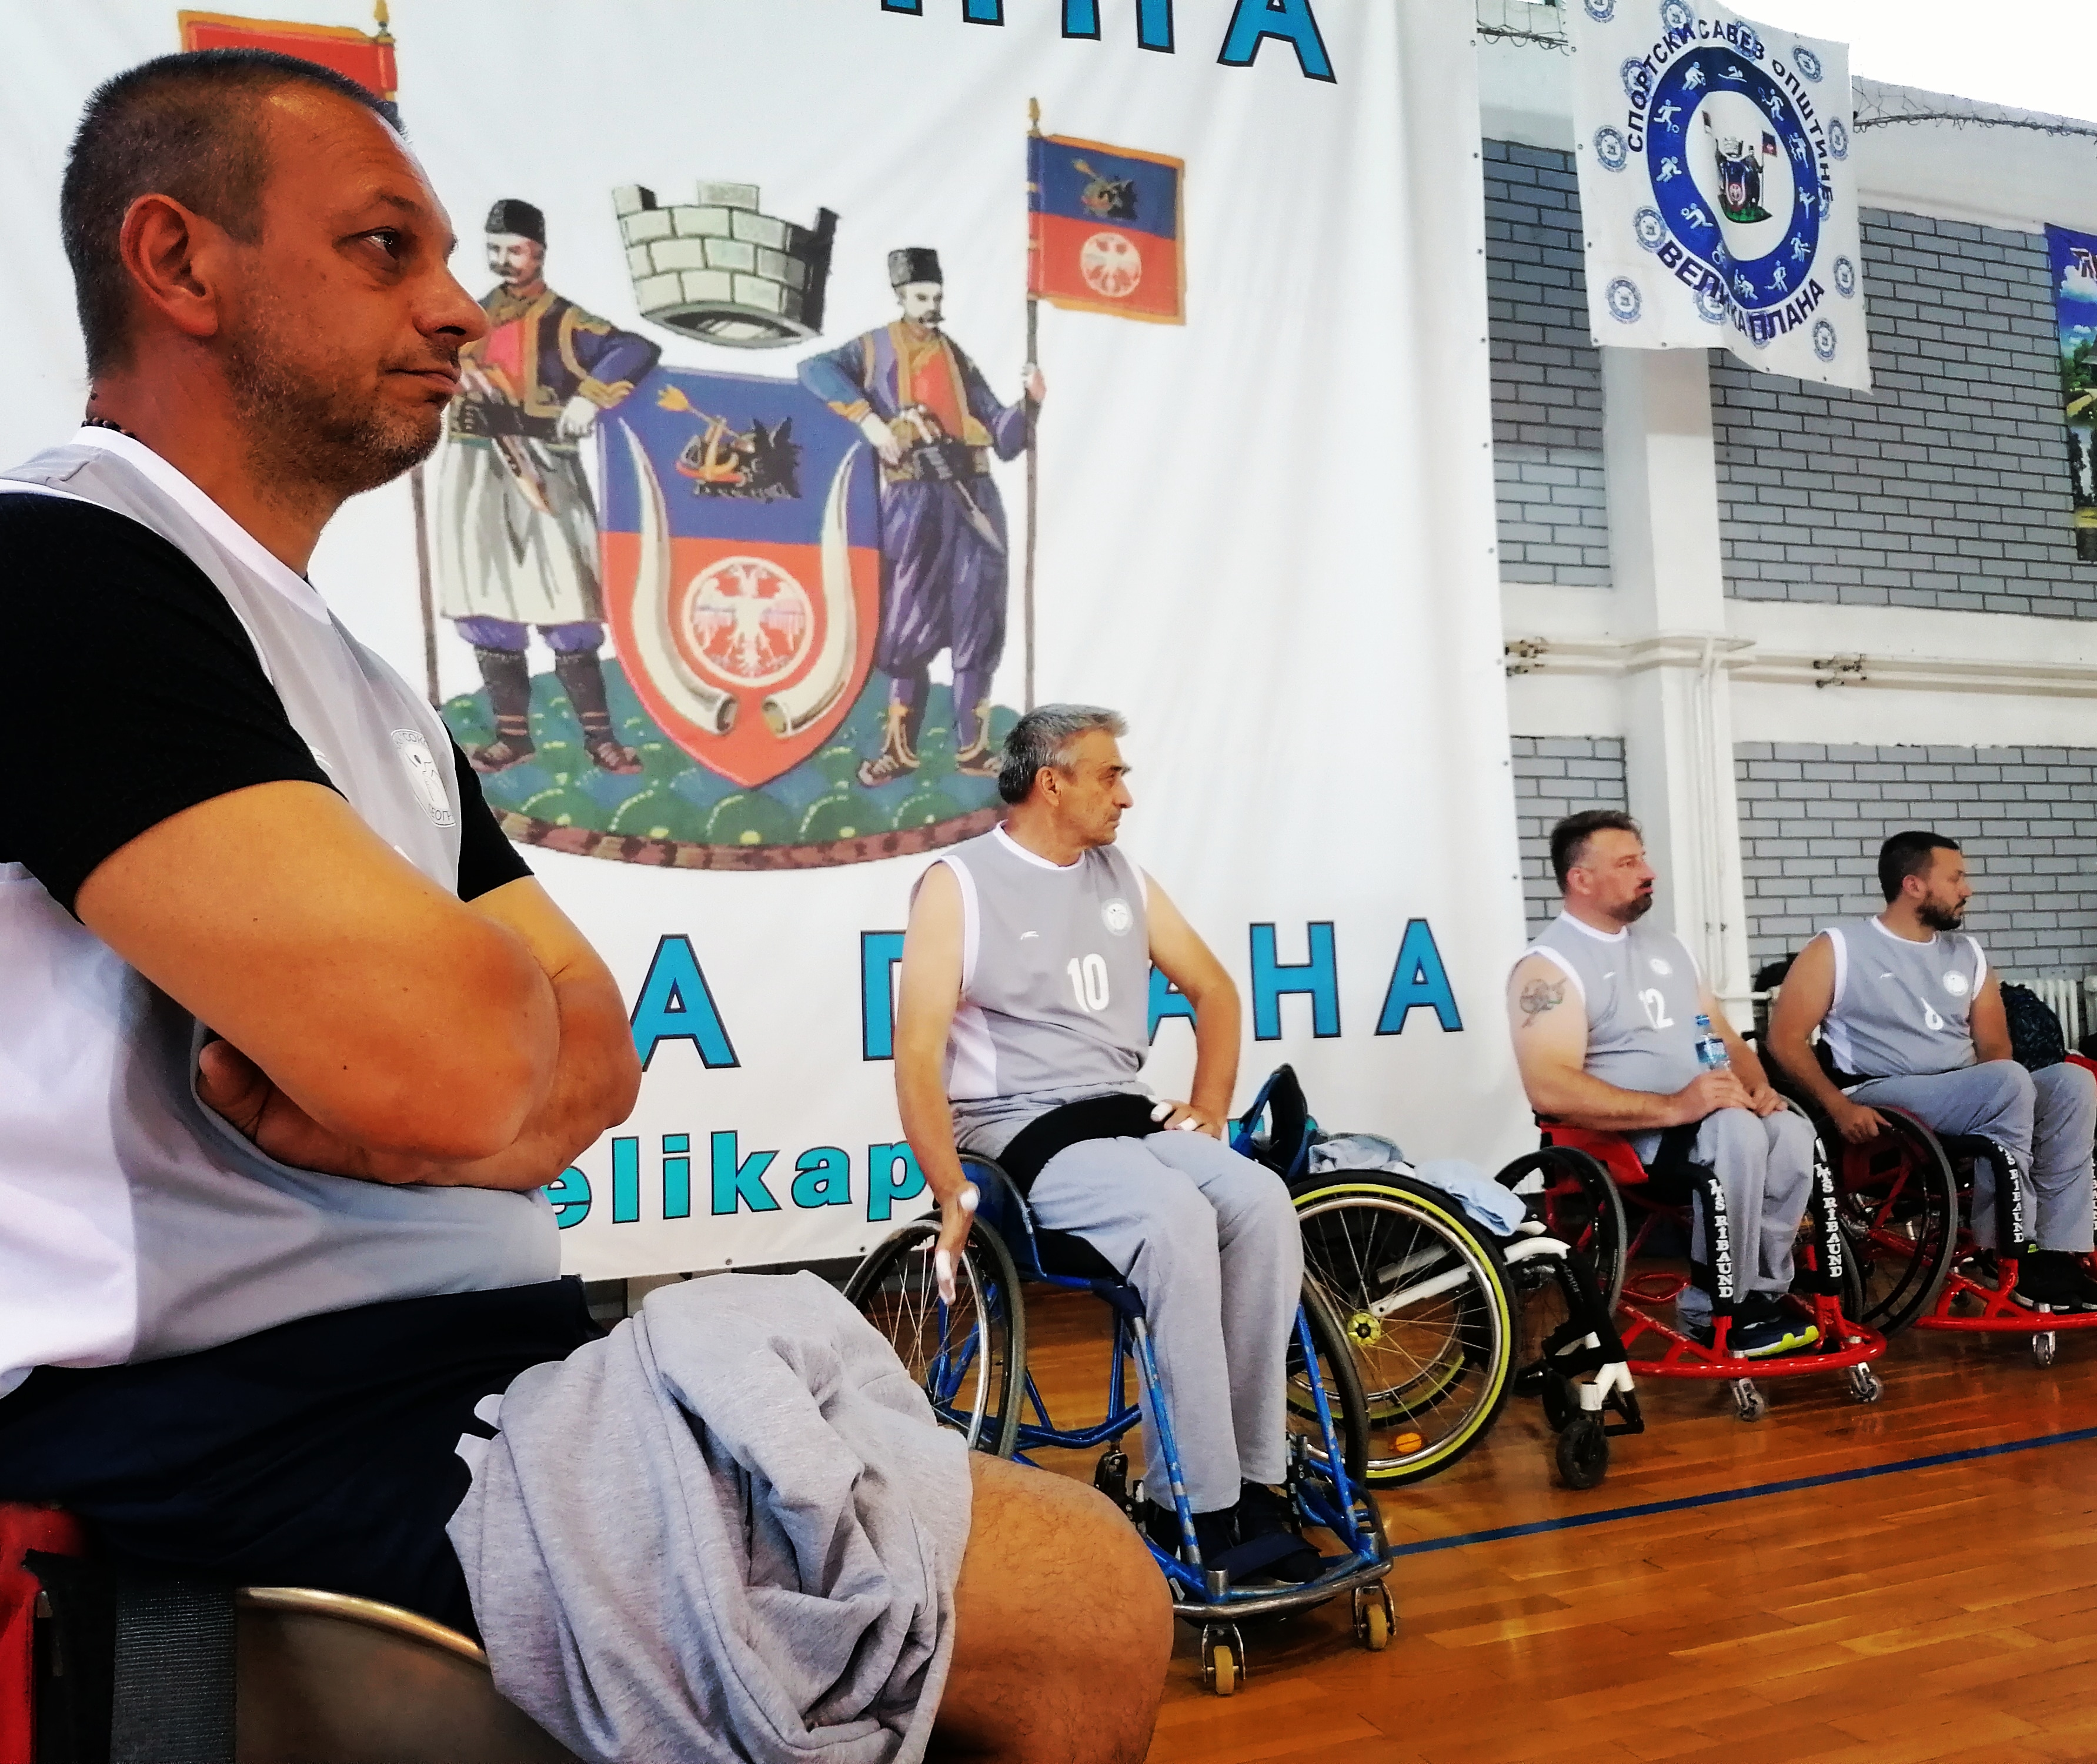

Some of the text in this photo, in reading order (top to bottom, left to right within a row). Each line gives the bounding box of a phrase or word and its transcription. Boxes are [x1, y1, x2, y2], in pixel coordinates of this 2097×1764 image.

[1628, 19, 1834, 201] СПОРТСКИ САВЕЗ ОПШТИНЕ
[1749, 278, 1825, 341] ПЛАНА
[1067, 953, 1110, 1012] 10
[1639, 988, 1674, 1029] 12
[1714, 1215, 1734, 1298] RIBAUND
[1822, 1197, 1843, 1278] RIBAUND
